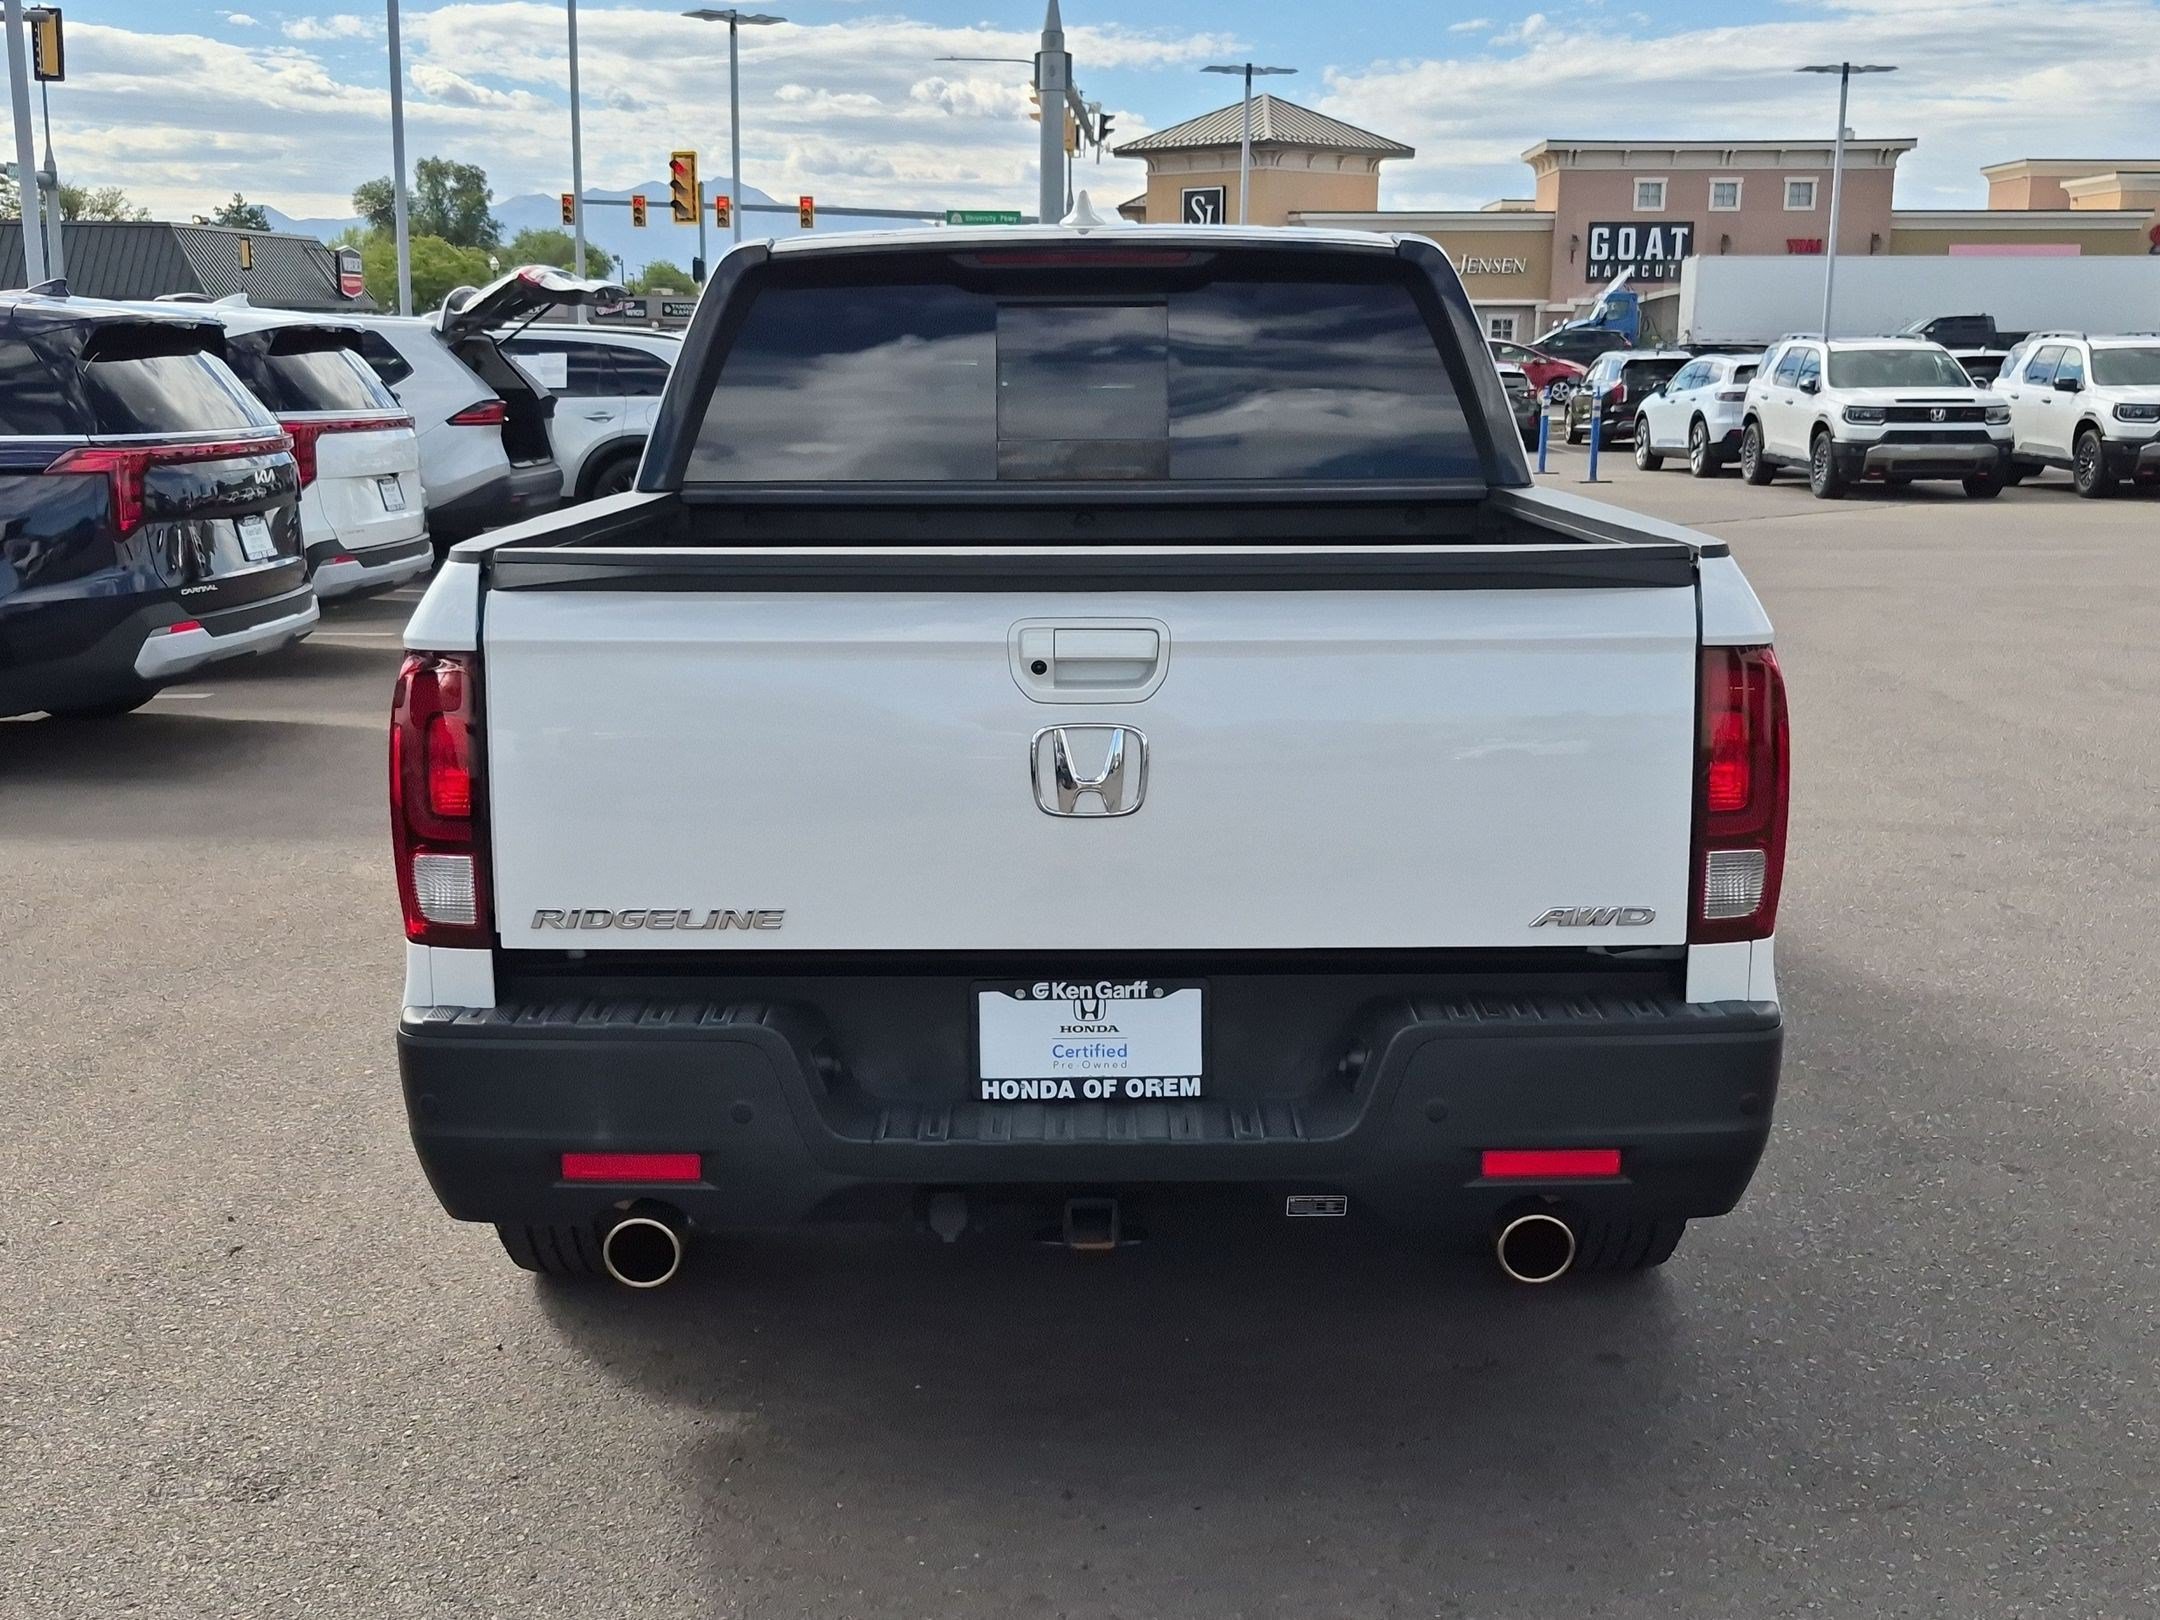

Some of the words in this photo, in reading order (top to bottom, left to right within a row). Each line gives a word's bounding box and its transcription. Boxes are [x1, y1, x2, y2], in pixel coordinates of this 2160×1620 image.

[1590, 227, 1689, 260] G.O.A.T.
[1459, 253, 1527, 275] JENSEN
[531, 908, 785, 930] RIDGELINE
[1528, 906, 1656, 928] AWD
[1052, 982, 1092, 999] Ken
[1095, 981, 1148, 999] Garff
[1060, 1025, 1120, 1033] HONDA
[1052, 1043, 1128, 1058] Certified
[981, 1079, 1075, 1100] HONDA
[1083, 1078, 1117, 1099] OF
[1125, 1077, 1201, 1098] OREM
